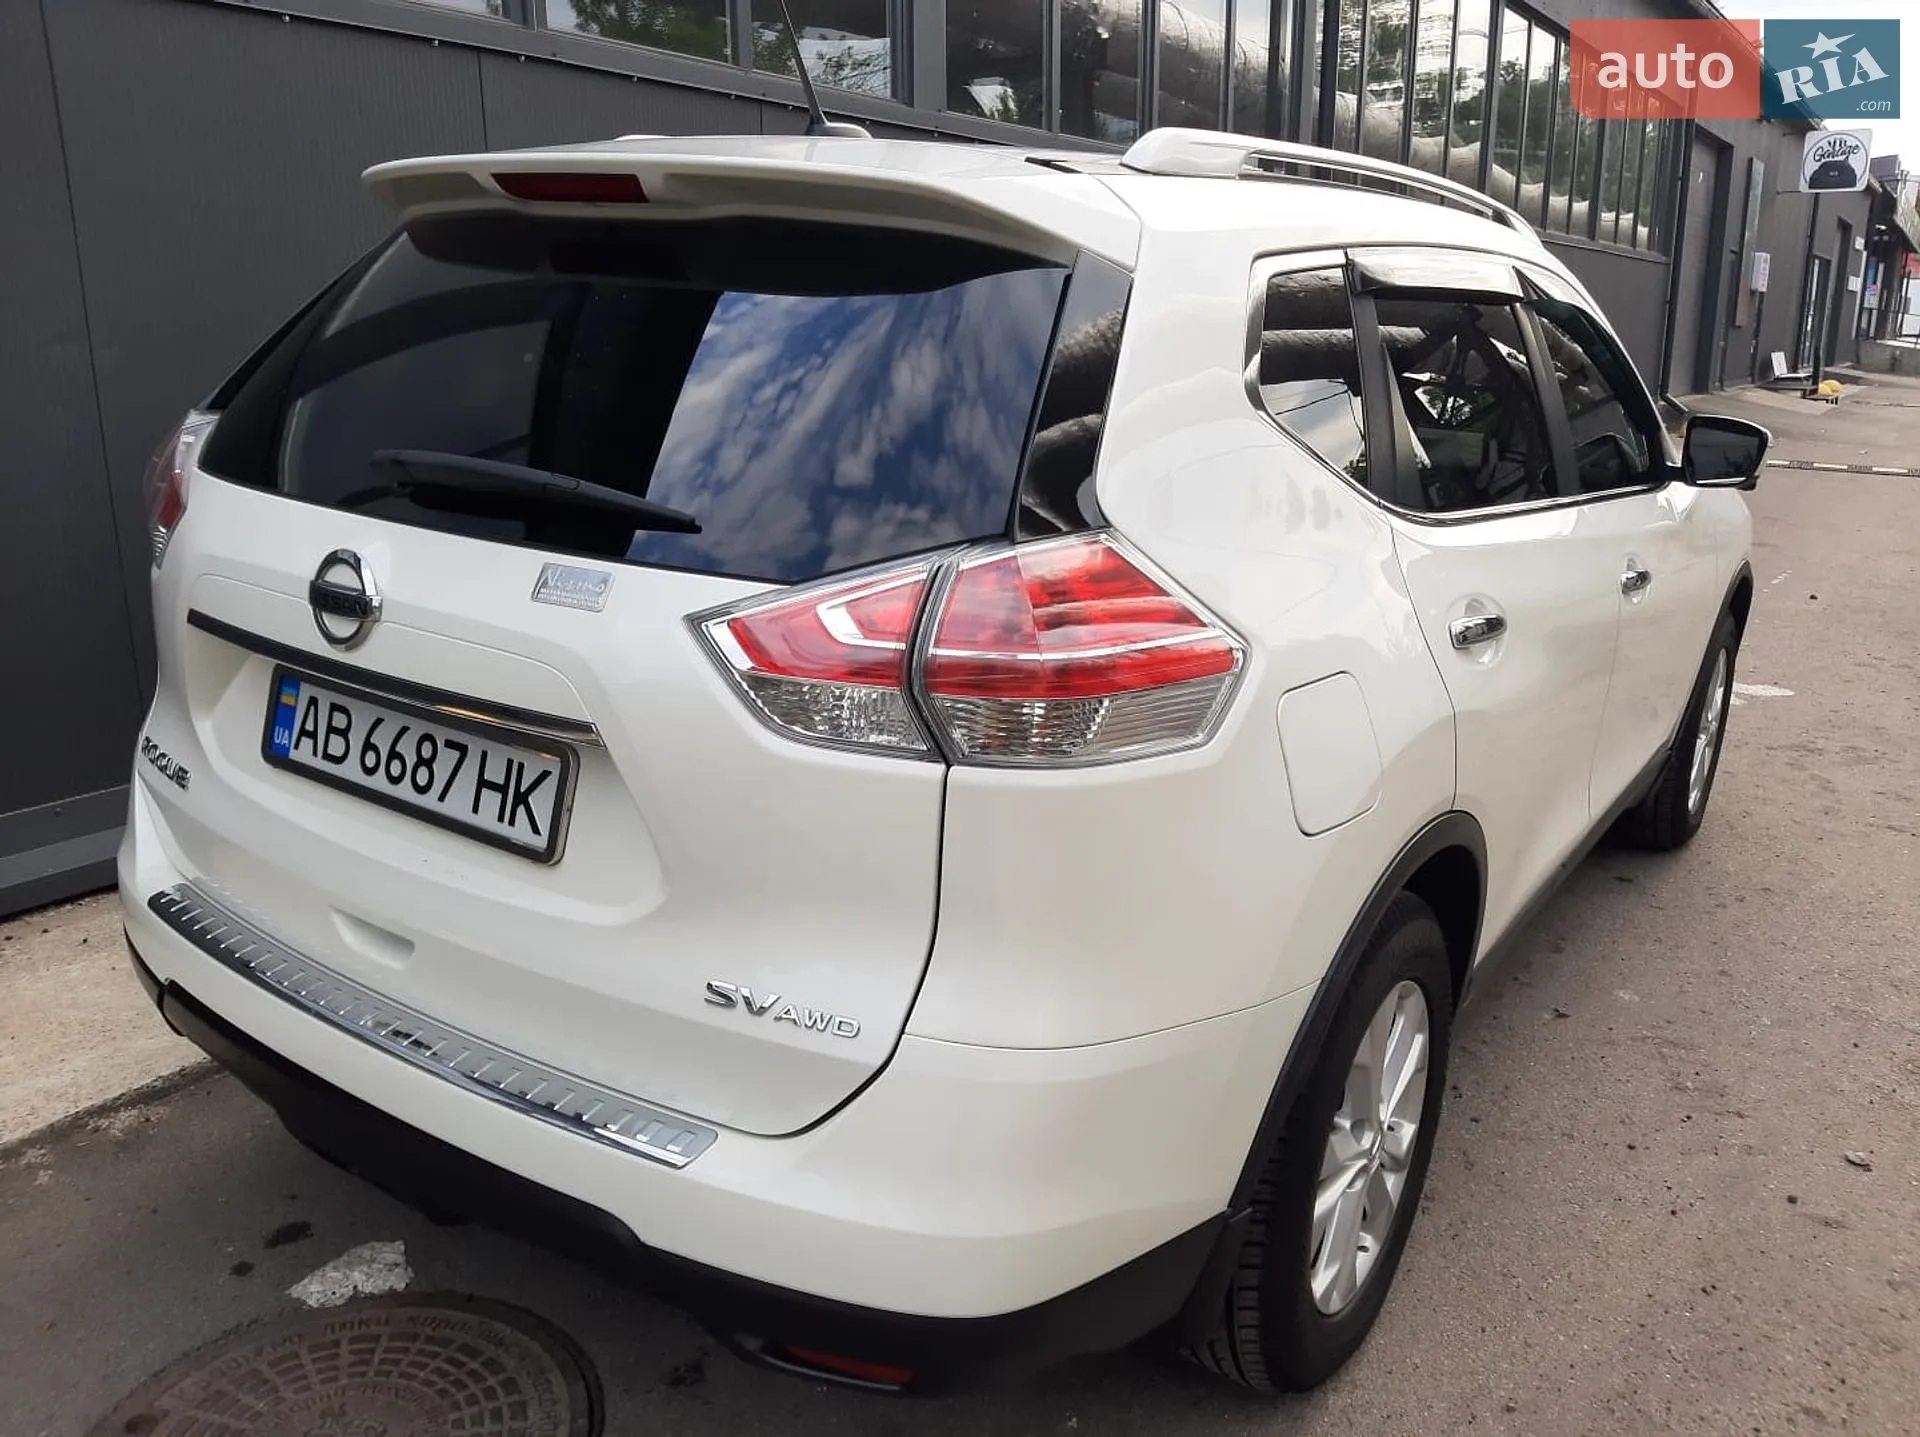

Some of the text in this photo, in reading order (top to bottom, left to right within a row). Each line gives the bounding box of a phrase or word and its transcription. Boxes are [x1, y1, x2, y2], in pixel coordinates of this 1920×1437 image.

[141, 735, 192, 792] ROGUE
[274, 725, 289, 747] UA
[293, 695, 552, 836] AB 6687 HK
[704, 979, 863, 1039] SV AWD
